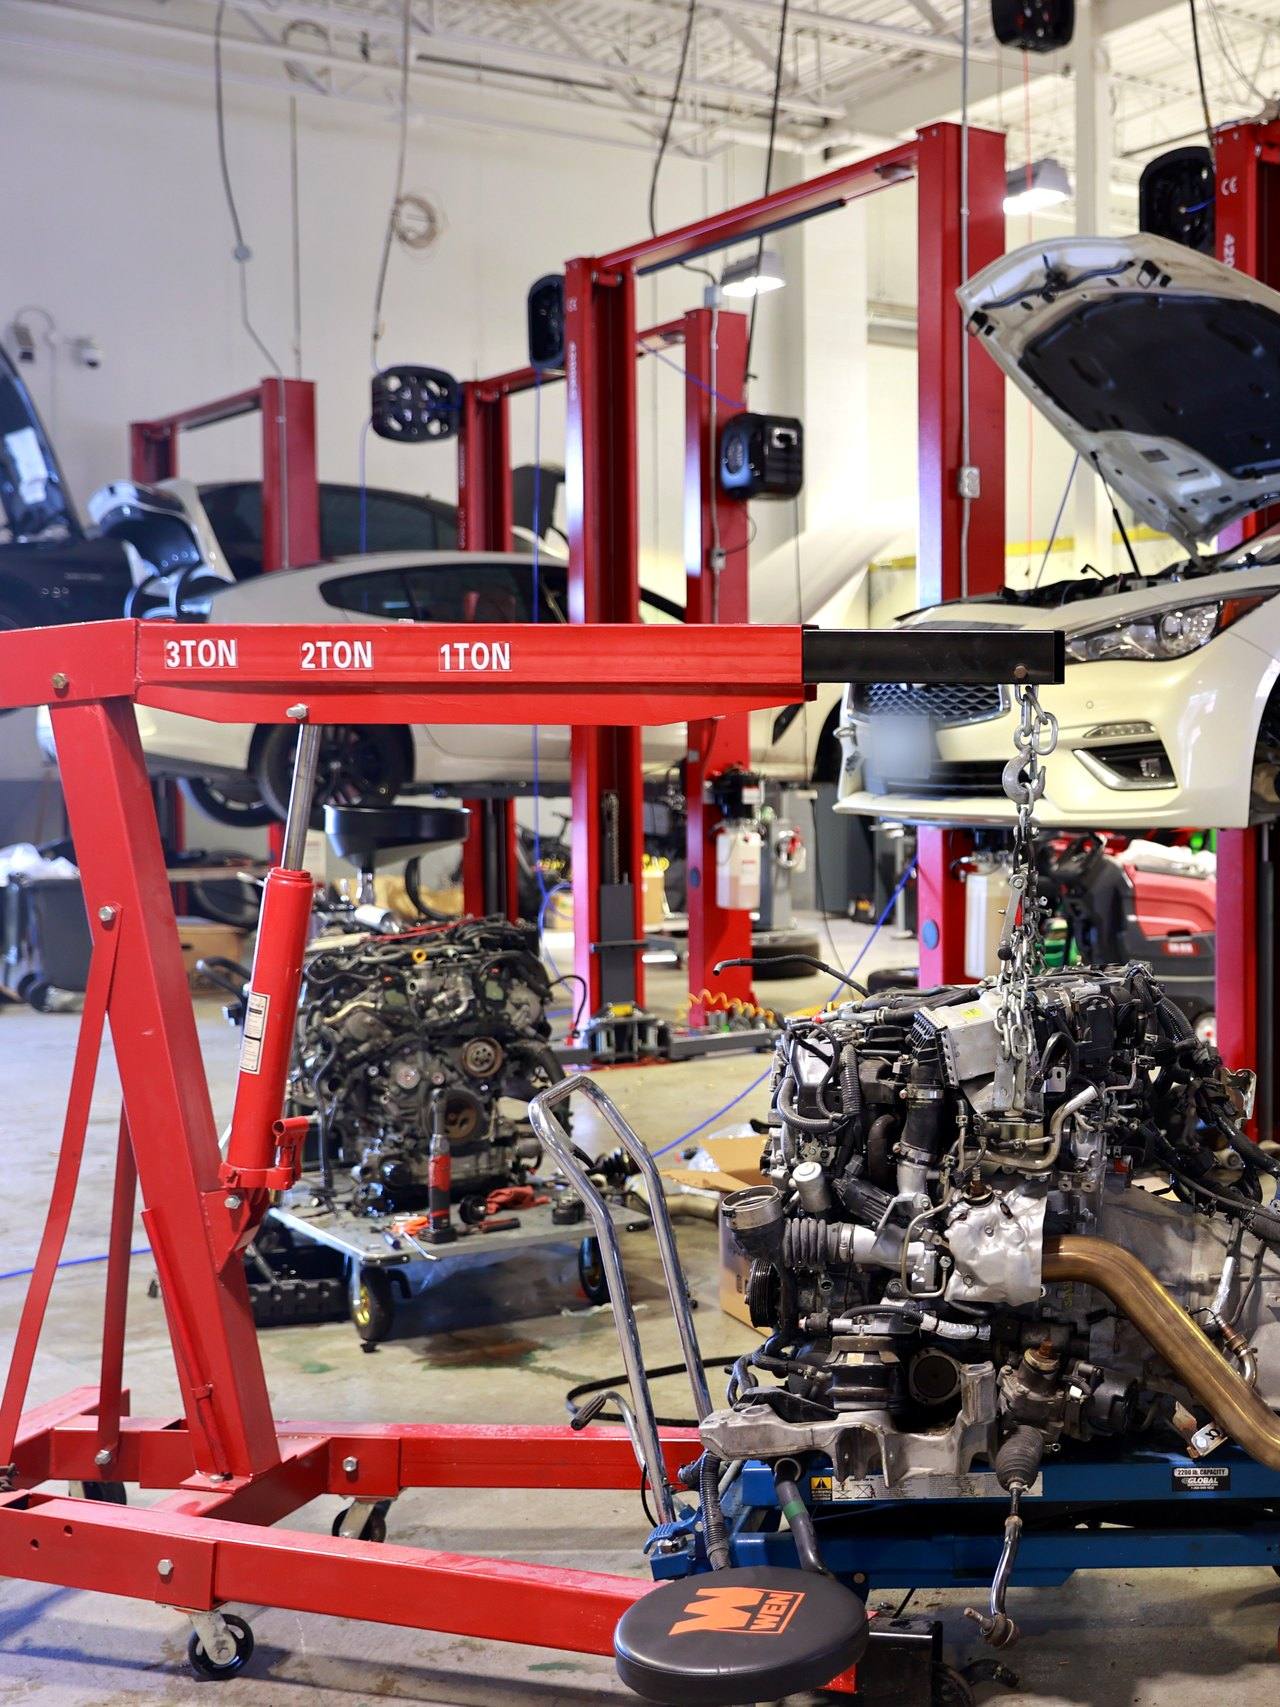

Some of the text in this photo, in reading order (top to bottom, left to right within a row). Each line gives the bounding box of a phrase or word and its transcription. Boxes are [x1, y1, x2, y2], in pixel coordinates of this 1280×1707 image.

[166, 639, 237, 668] 3TON
[301, 641, 373, 668] 2TON
[440, 642, 511, 670] 1TON
[749, 1592, 795, 1631] WEN
